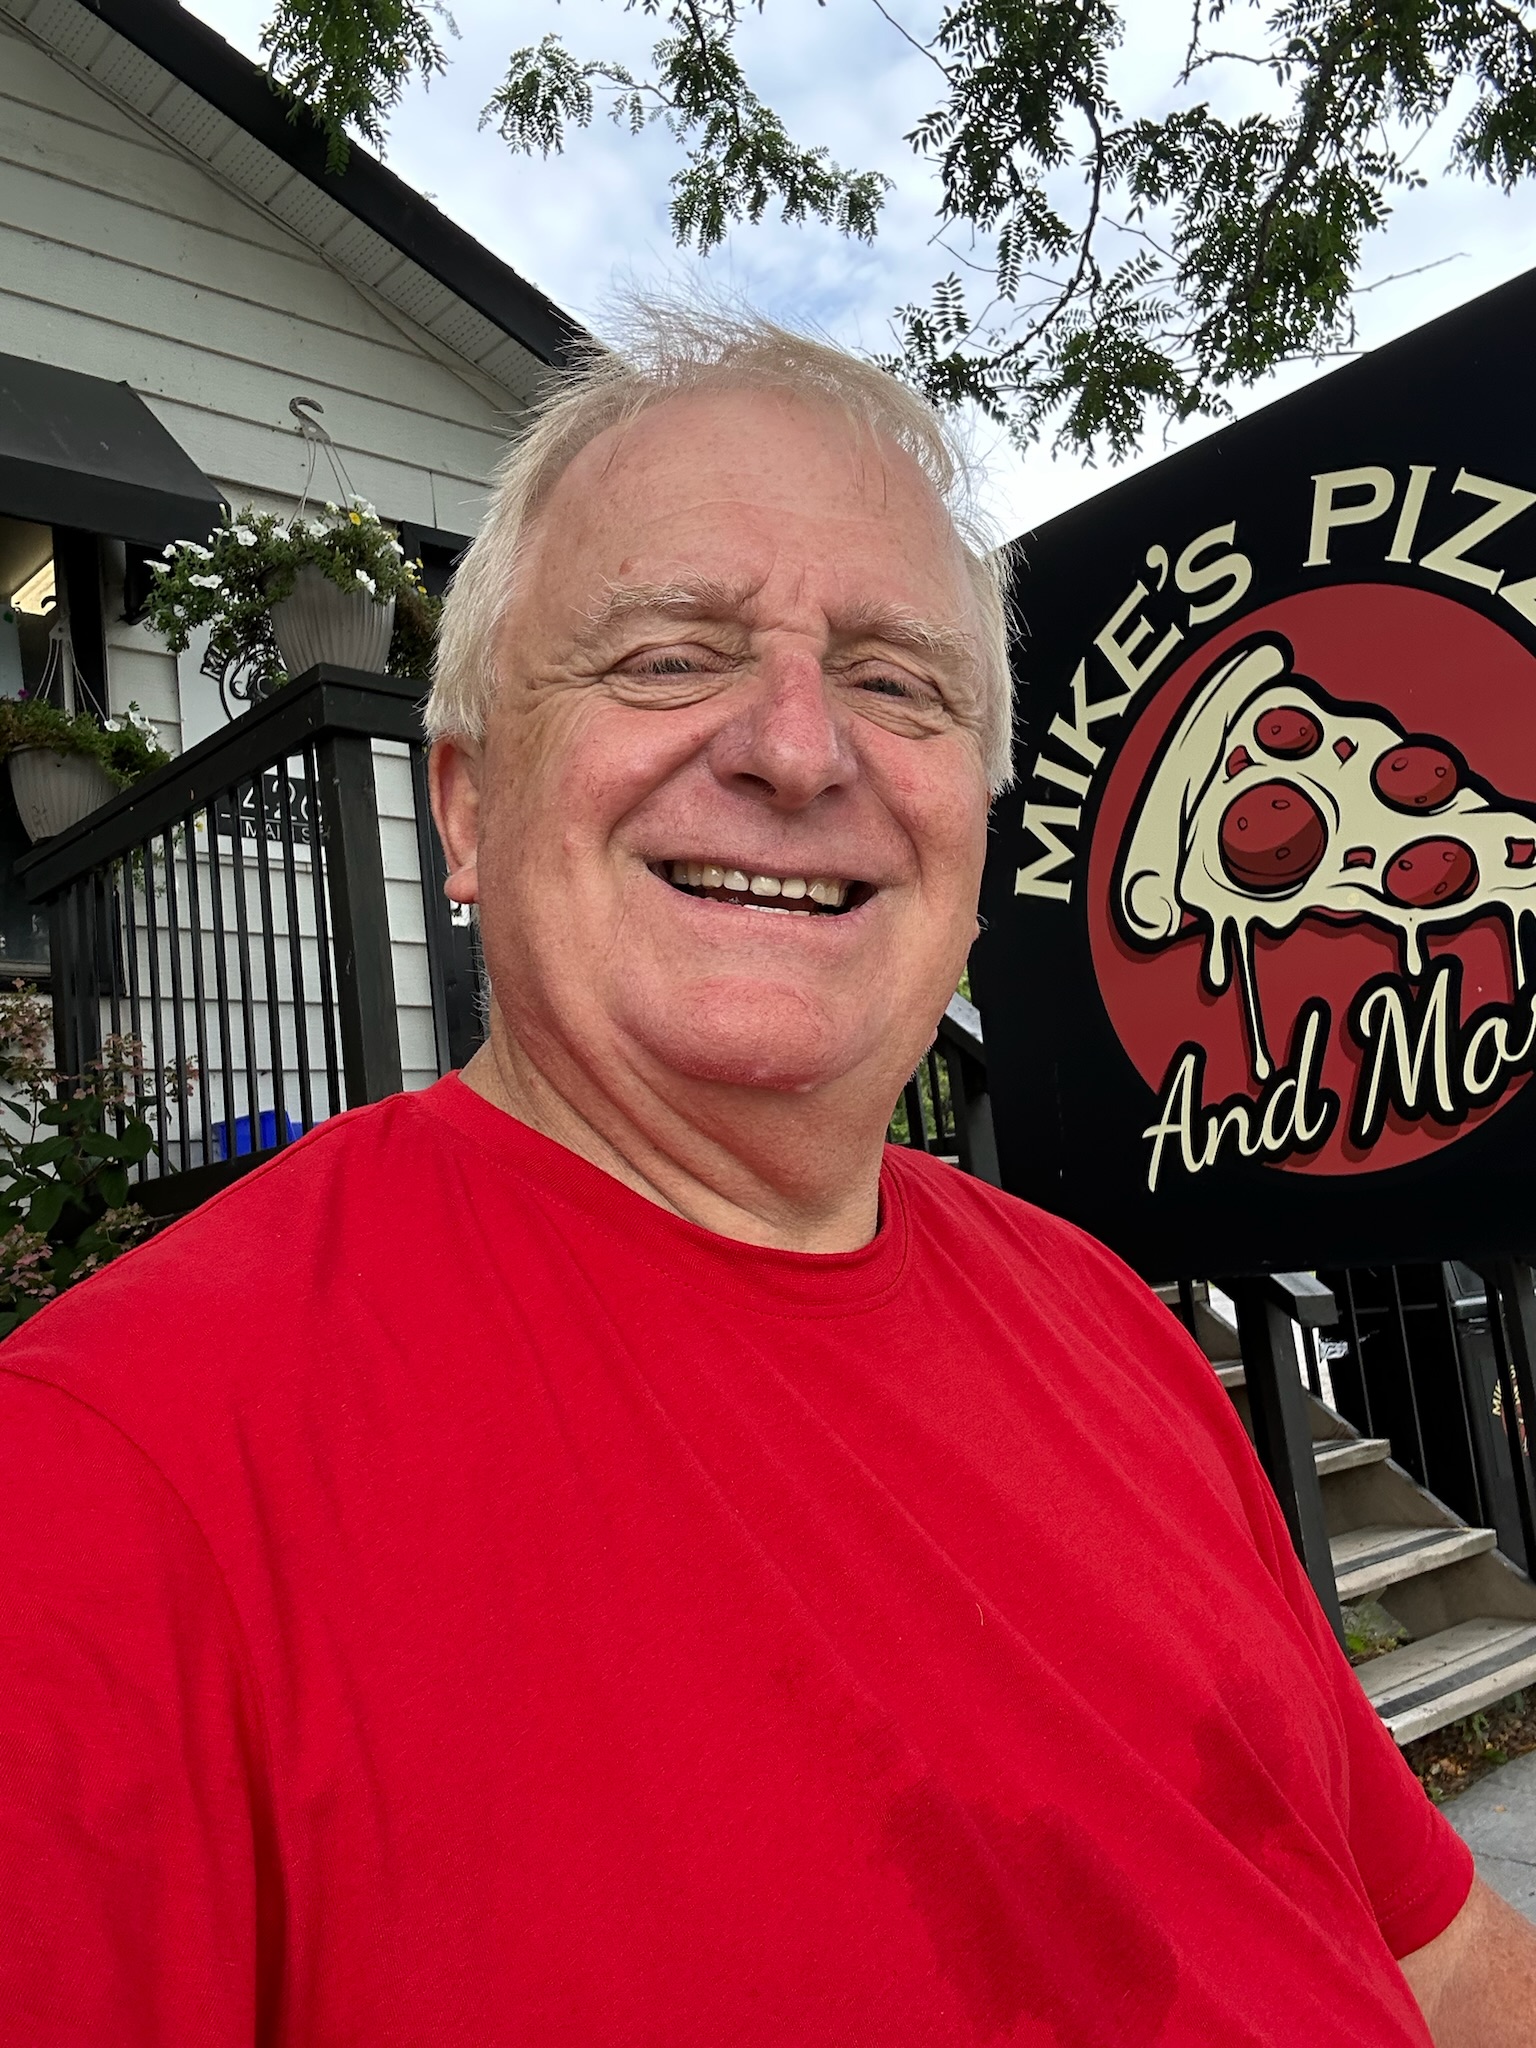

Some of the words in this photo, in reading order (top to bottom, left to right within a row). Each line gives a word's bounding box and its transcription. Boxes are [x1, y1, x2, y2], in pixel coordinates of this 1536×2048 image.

[1014, 520, 1253, 904] MIKE'S
[1142, 1010, 1328, 1193] And
[1359, 968, 1536, 1136] Mo
